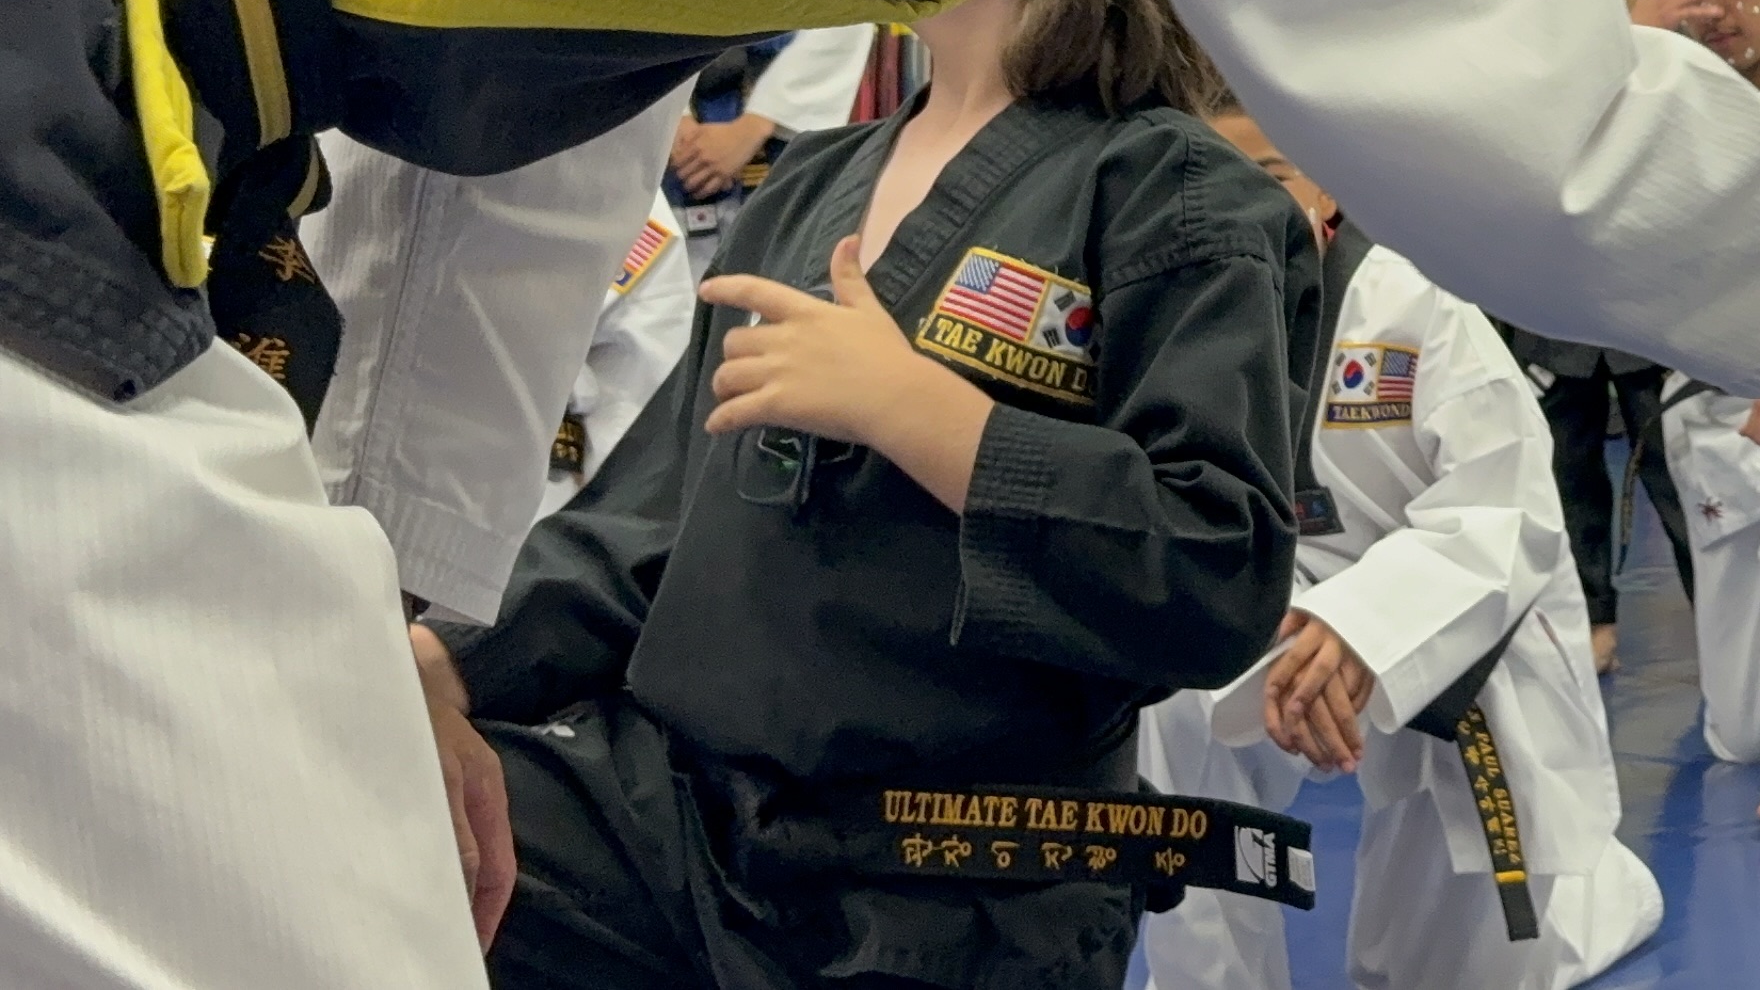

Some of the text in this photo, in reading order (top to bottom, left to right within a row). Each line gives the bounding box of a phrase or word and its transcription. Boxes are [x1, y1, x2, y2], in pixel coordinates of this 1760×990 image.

[934, 317, 984, 355] TAE
[985, 337, 1068, 388] KWON
[884, 789, 1207, 839] ULTIMATE TAE KWON DO
